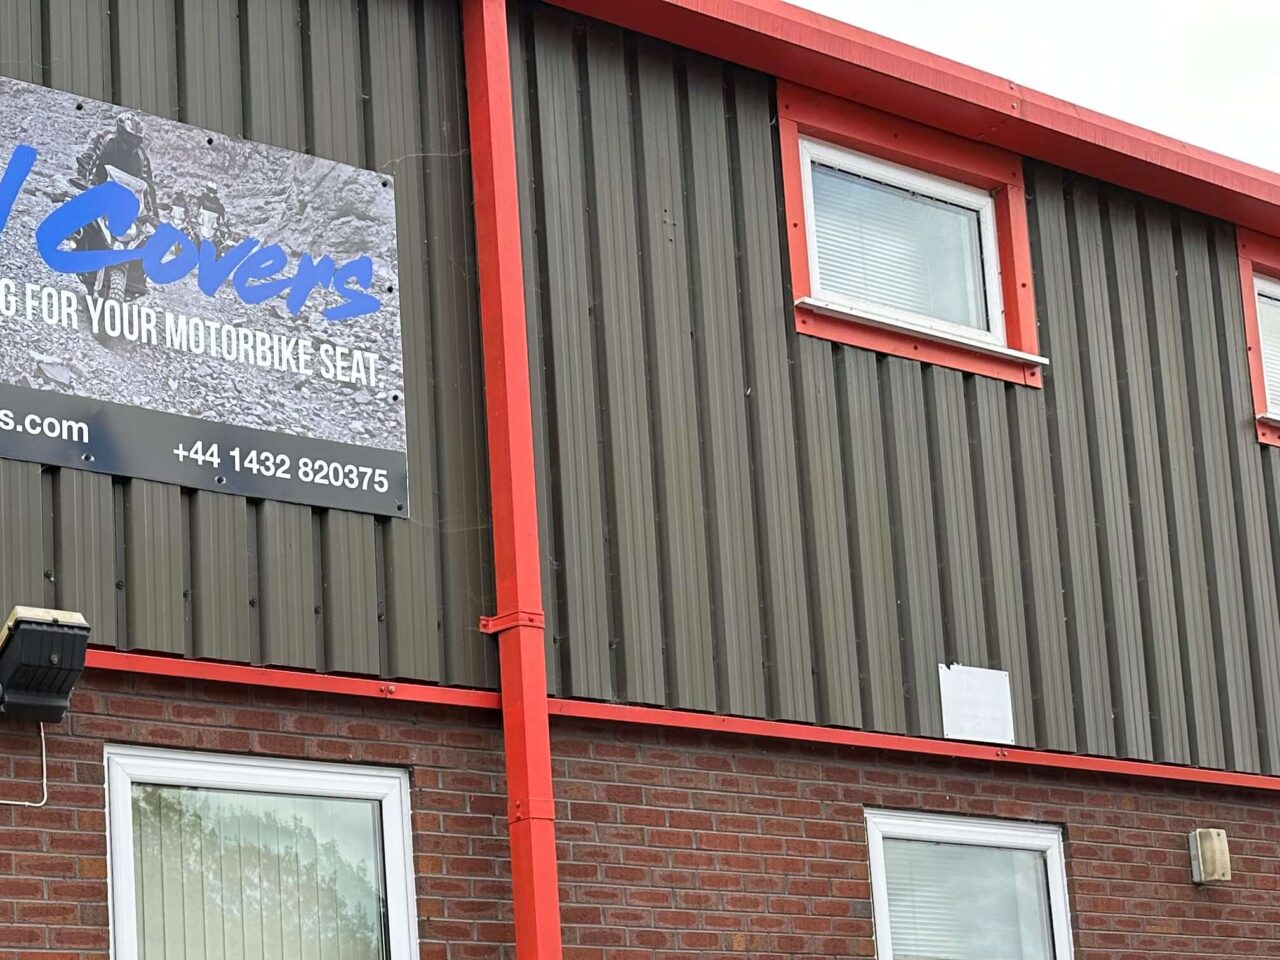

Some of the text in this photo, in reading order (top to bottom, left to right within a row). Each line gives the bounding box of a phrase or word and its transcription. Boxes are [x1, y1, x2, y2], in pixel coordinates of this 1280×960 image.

[36, 181, 381, 320] Covers
[25, 283, 78, 330] FOR
[85, 294, 158, 345] YOUR
[165, 308, 313, 376] MOTORBIKE
[319, 343, 384, 388] SEAT.
[173, 440, 389, 493] +44 1432 820375
